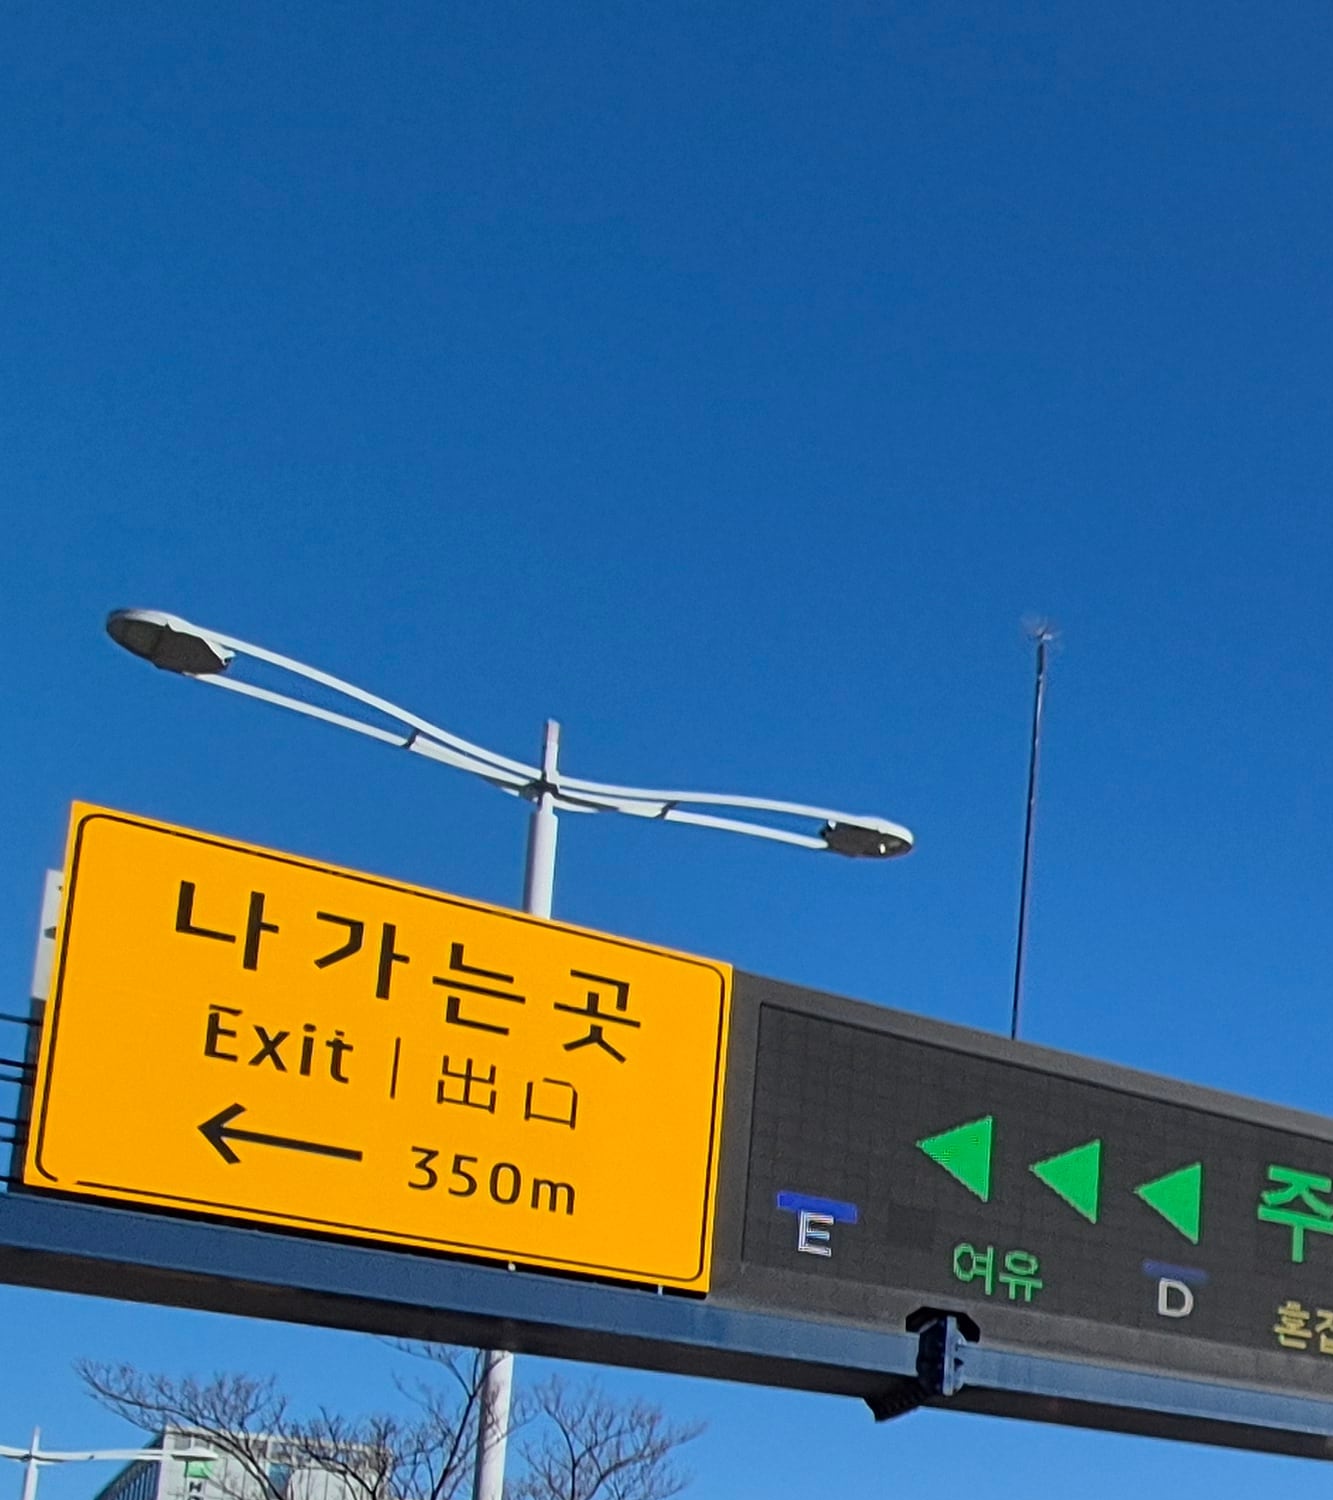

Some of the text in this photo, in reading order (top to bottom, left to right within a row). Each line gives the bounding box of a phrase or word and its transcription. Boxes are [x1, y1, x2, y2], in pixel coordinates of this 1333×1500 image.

[204, 1004, 354, 1084] Exit
[437, 1055, 578, 1129] 出口
[408, 1146, 576, 1216] 350m
[797, 1211, 834, 1257] E
[952, 1242, 1043, 1302] 여유
[1157, 1277, 1194, 1318] D
